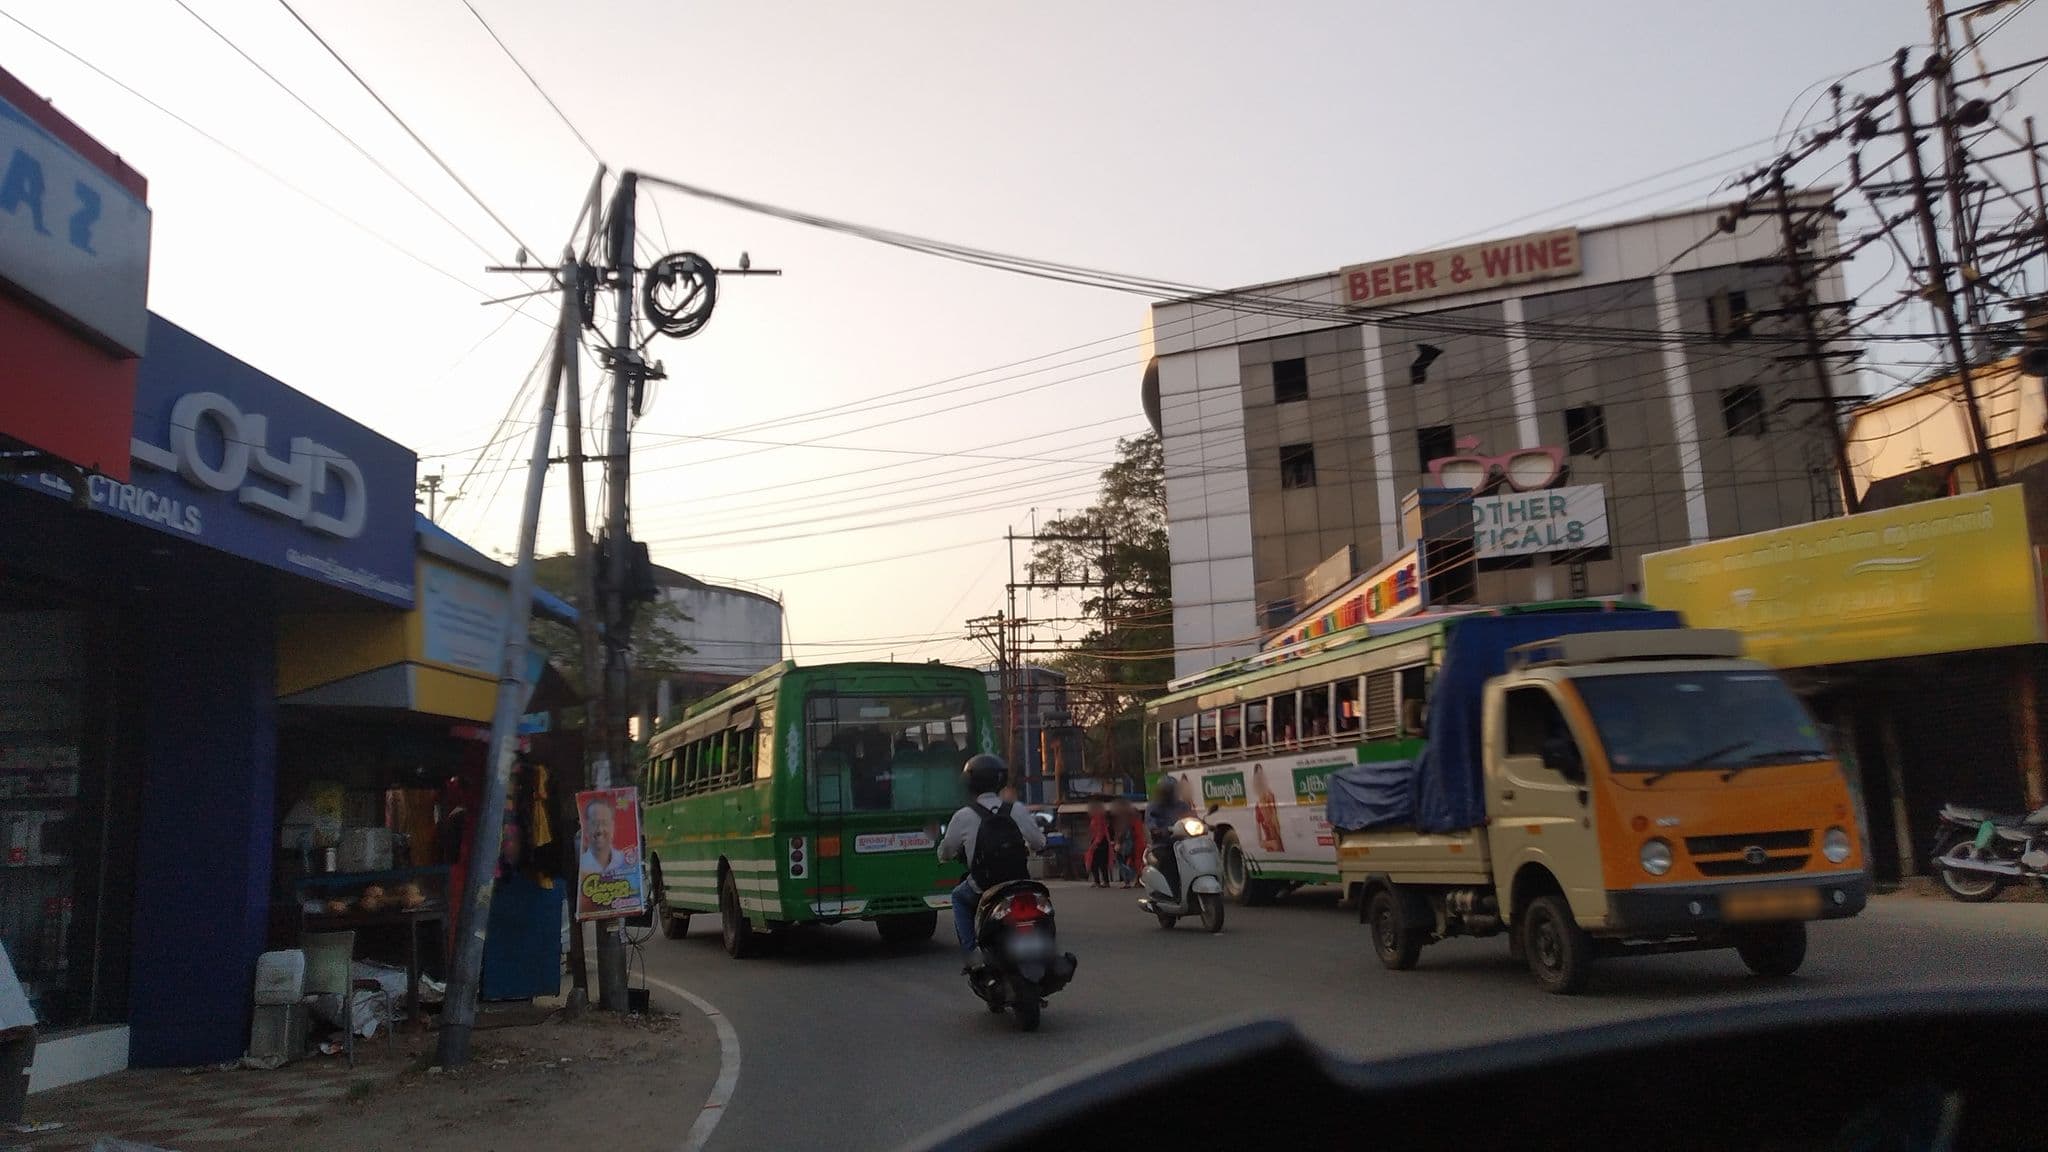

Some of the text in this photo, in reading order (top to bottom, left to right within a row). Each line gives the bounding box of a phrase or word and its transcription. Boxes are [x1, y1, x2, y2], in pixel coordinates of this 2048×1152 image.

[1347, 234, 1574, 302] BEER & WINE
